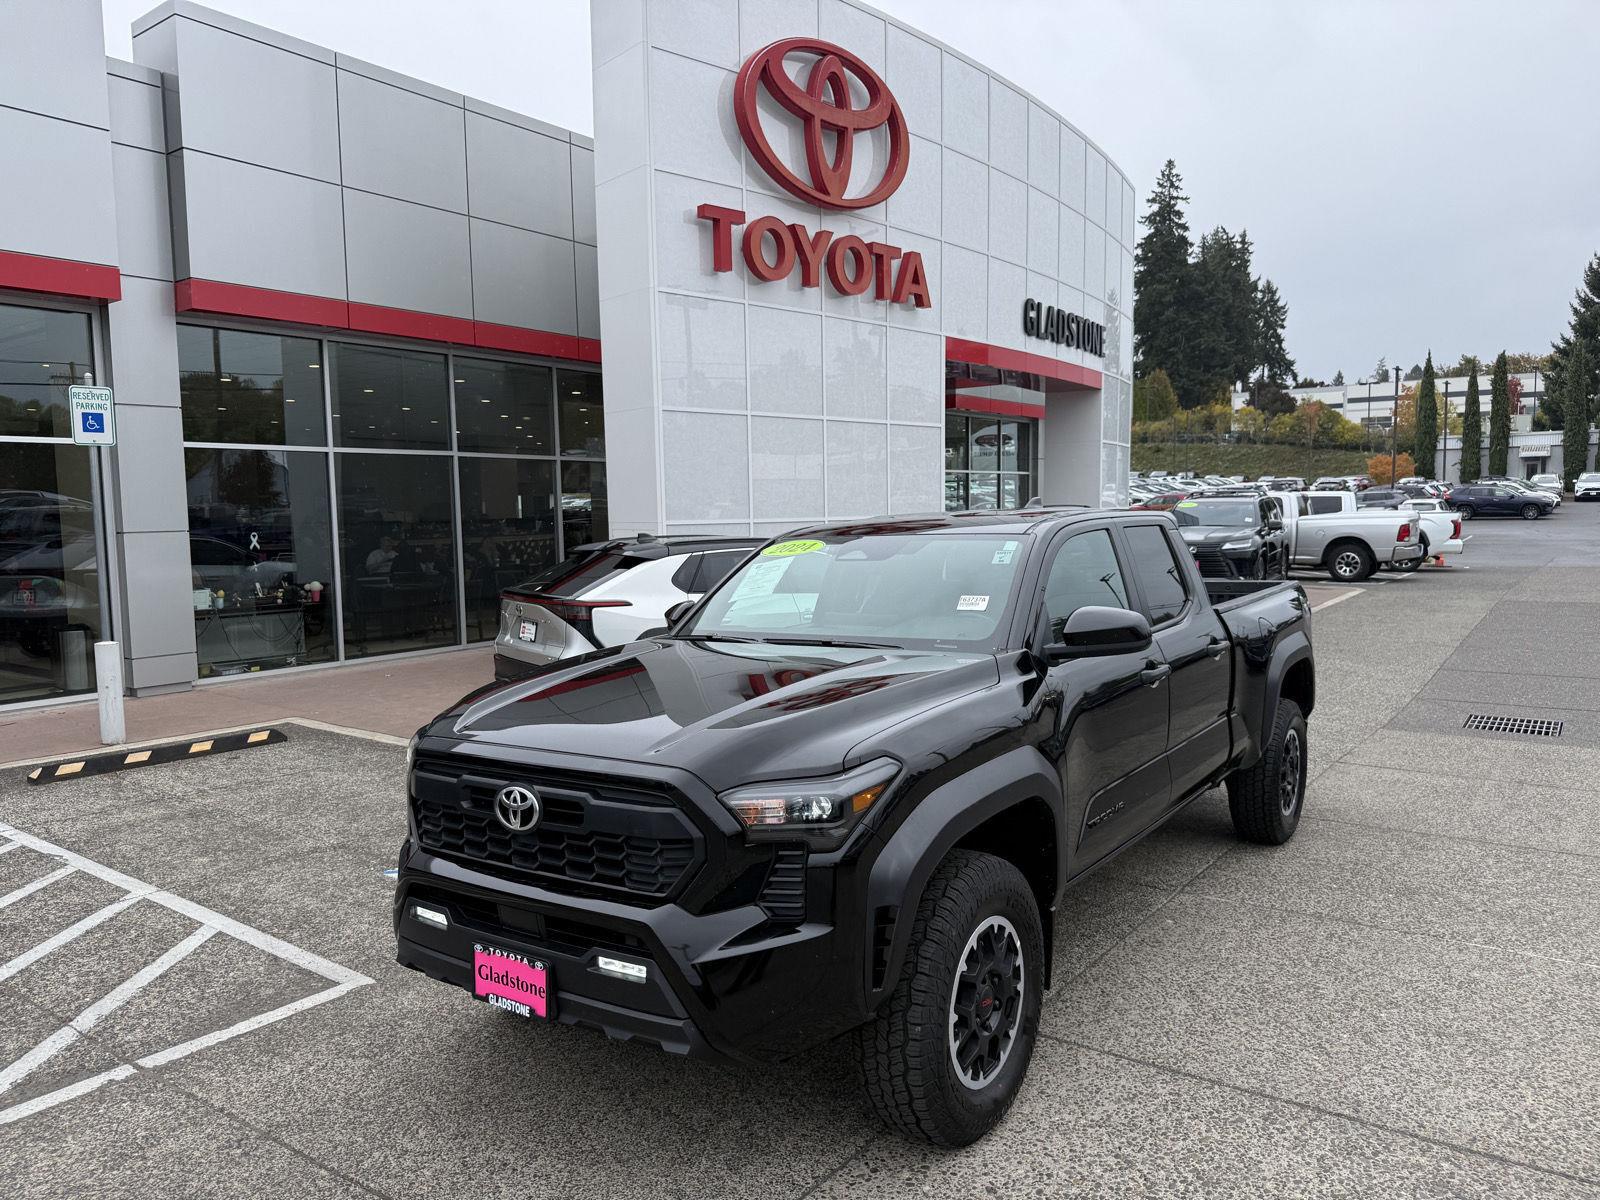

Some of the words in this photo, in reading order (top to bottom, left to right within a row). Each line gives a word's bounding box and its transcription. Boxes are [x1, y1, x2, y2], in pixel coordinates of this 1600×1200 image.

[697, 204, 932, 308] TOYOTA
[1023, 298, 1106, 358] GLADSTONE
[72, 391, 110, 401] RESERVED
[75, 402, 108, 411] PARKING
[488, 947, 529, 966] TOYOTA
[477, 964, 546, 999] Gladstone
[488, 993, 531, 1018] GLADSTONE
